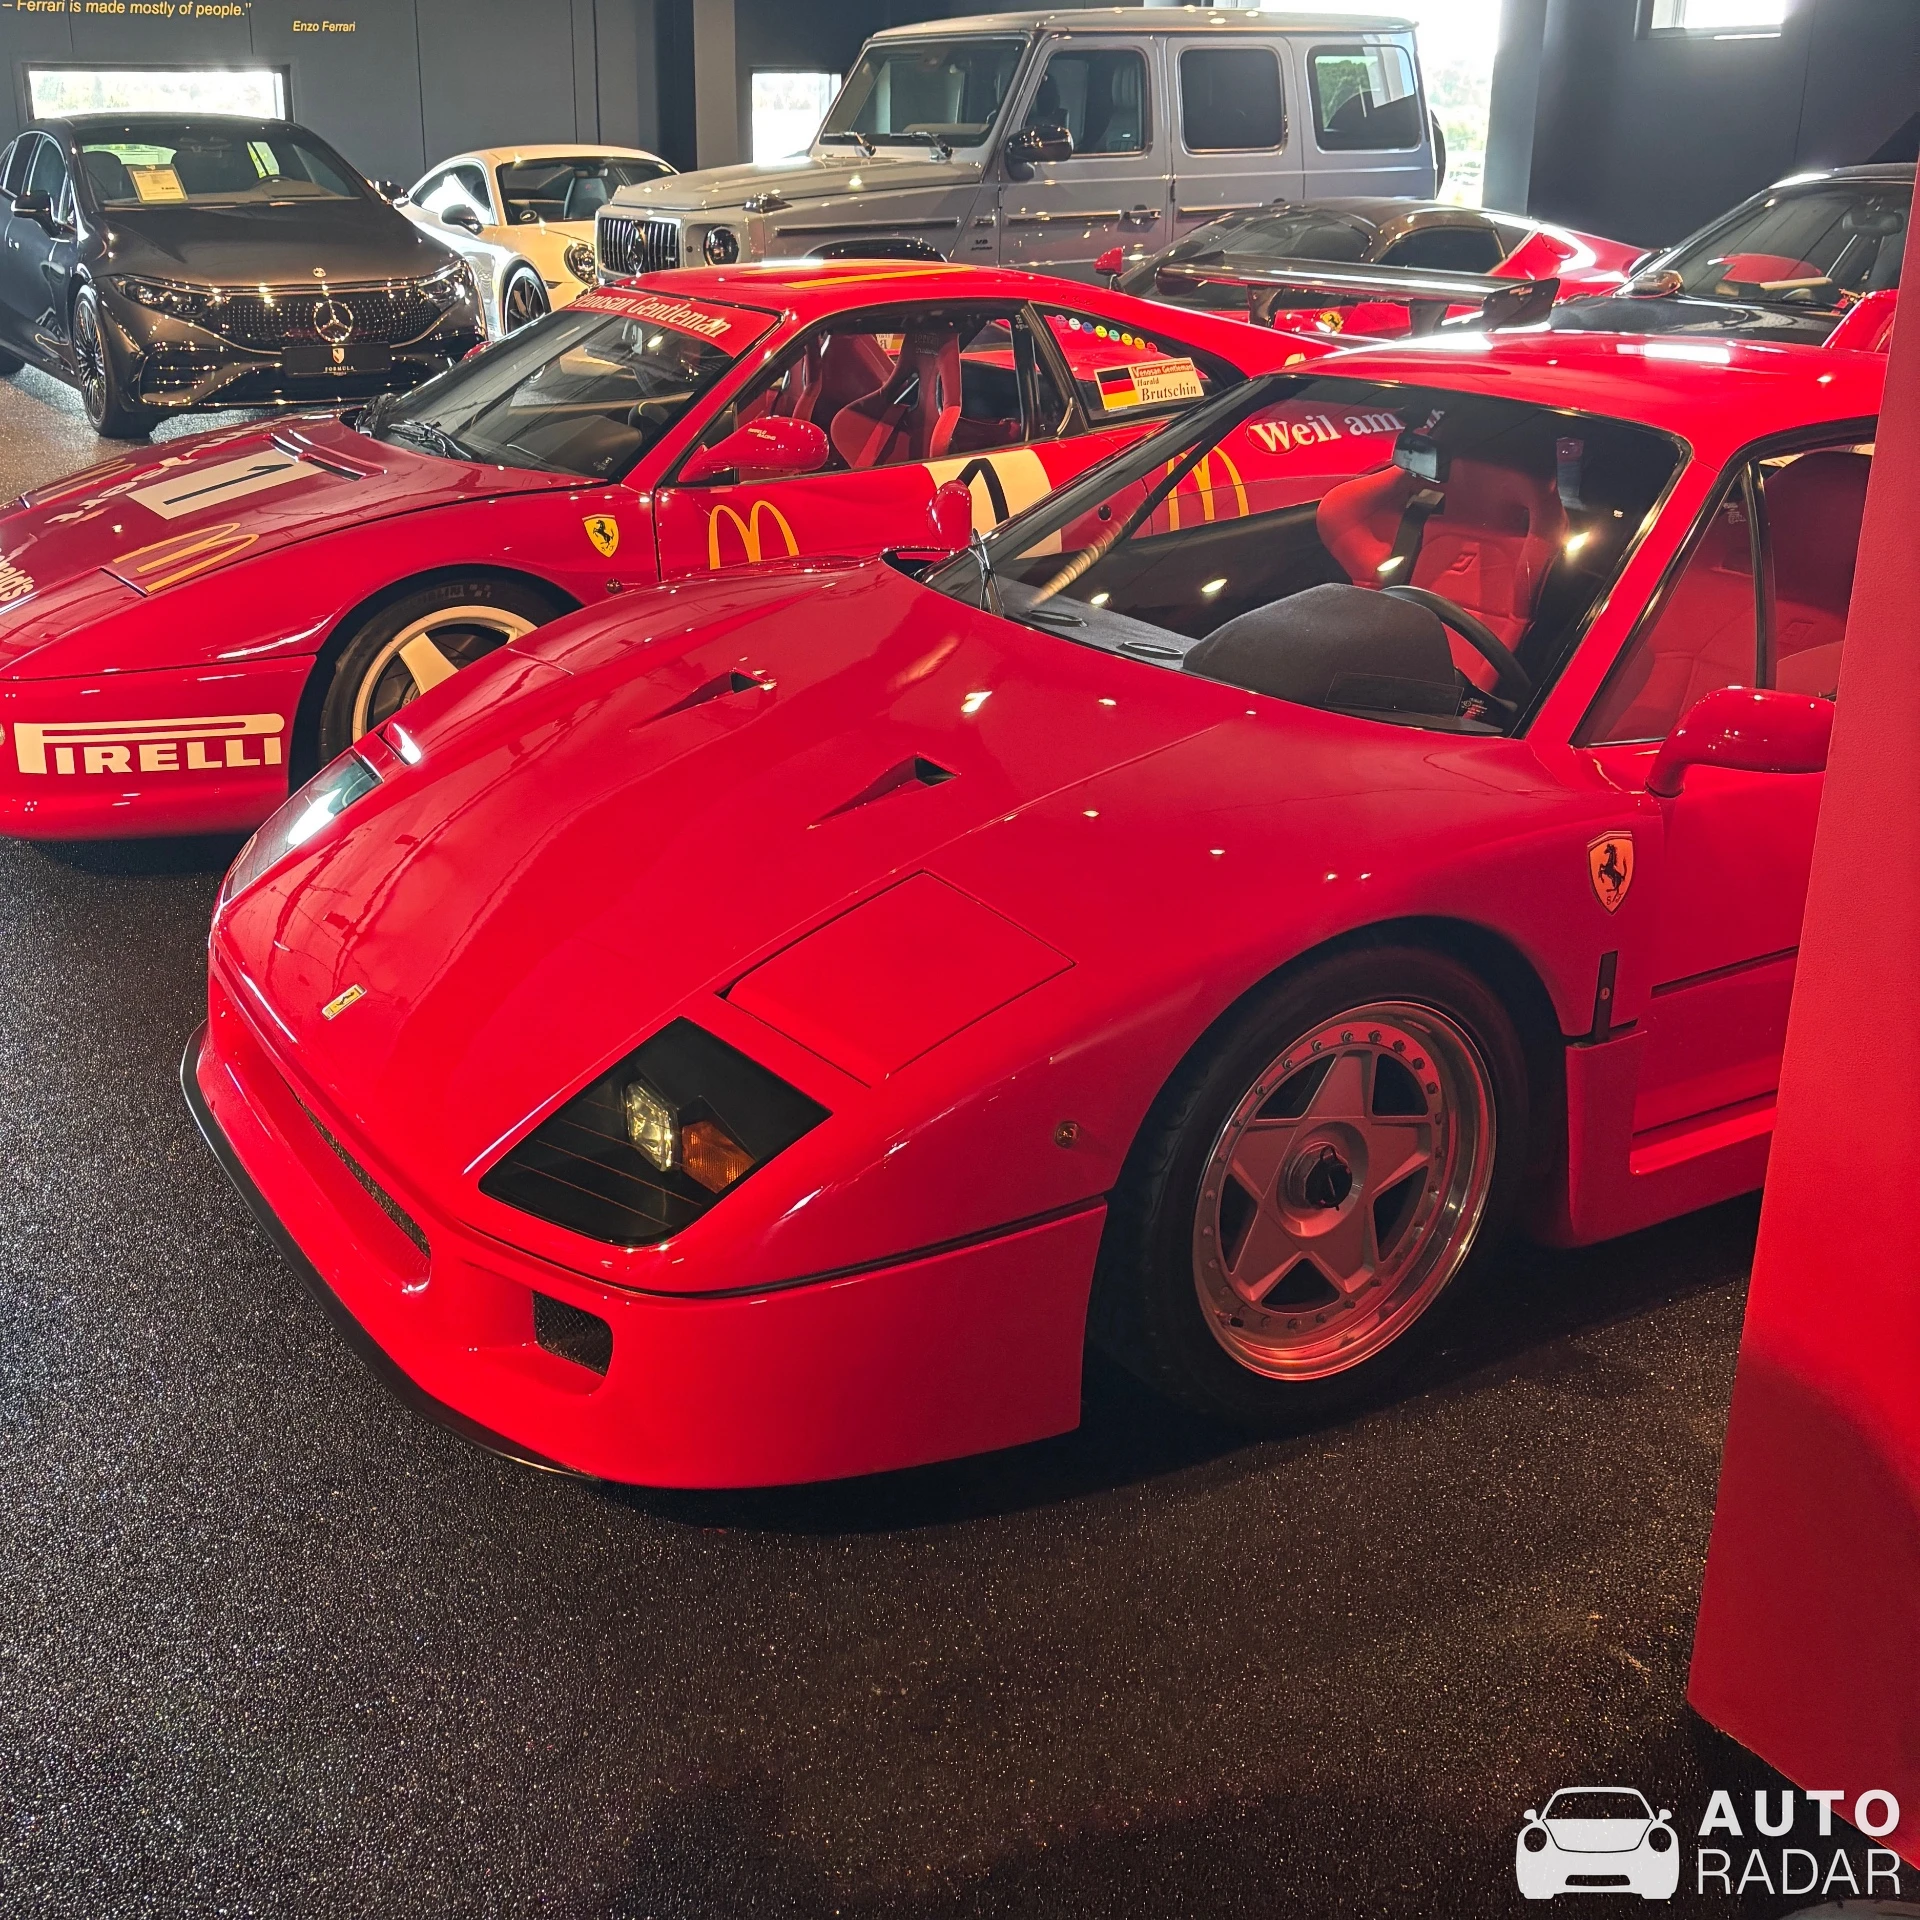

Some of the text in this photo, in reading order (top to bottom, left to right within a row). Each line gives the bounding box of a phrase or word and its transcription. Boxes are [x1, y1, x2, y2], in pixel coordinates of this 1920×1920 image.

[16, 0, 66, 12] Ferrari
[69, 0, 82, 12] is
[85, 0, 126, 14] made
[129, 1, 176, 18] mostly
[178, 1, 194, 15] of
[293, 20, 356, 32] Enzo Ferrari
[626, 296, 733, 339] Gentleman
[1132, 366, 1161, 378] Venosan
[1137, 377, 1160, 387] Harald
[1142, 382, 1197, 401] Brutschin
[1250, 414, 1342, 453] Weil
[1343, 412, 1406, 437] am
[13, 712, 286, 775] PIRELLI
